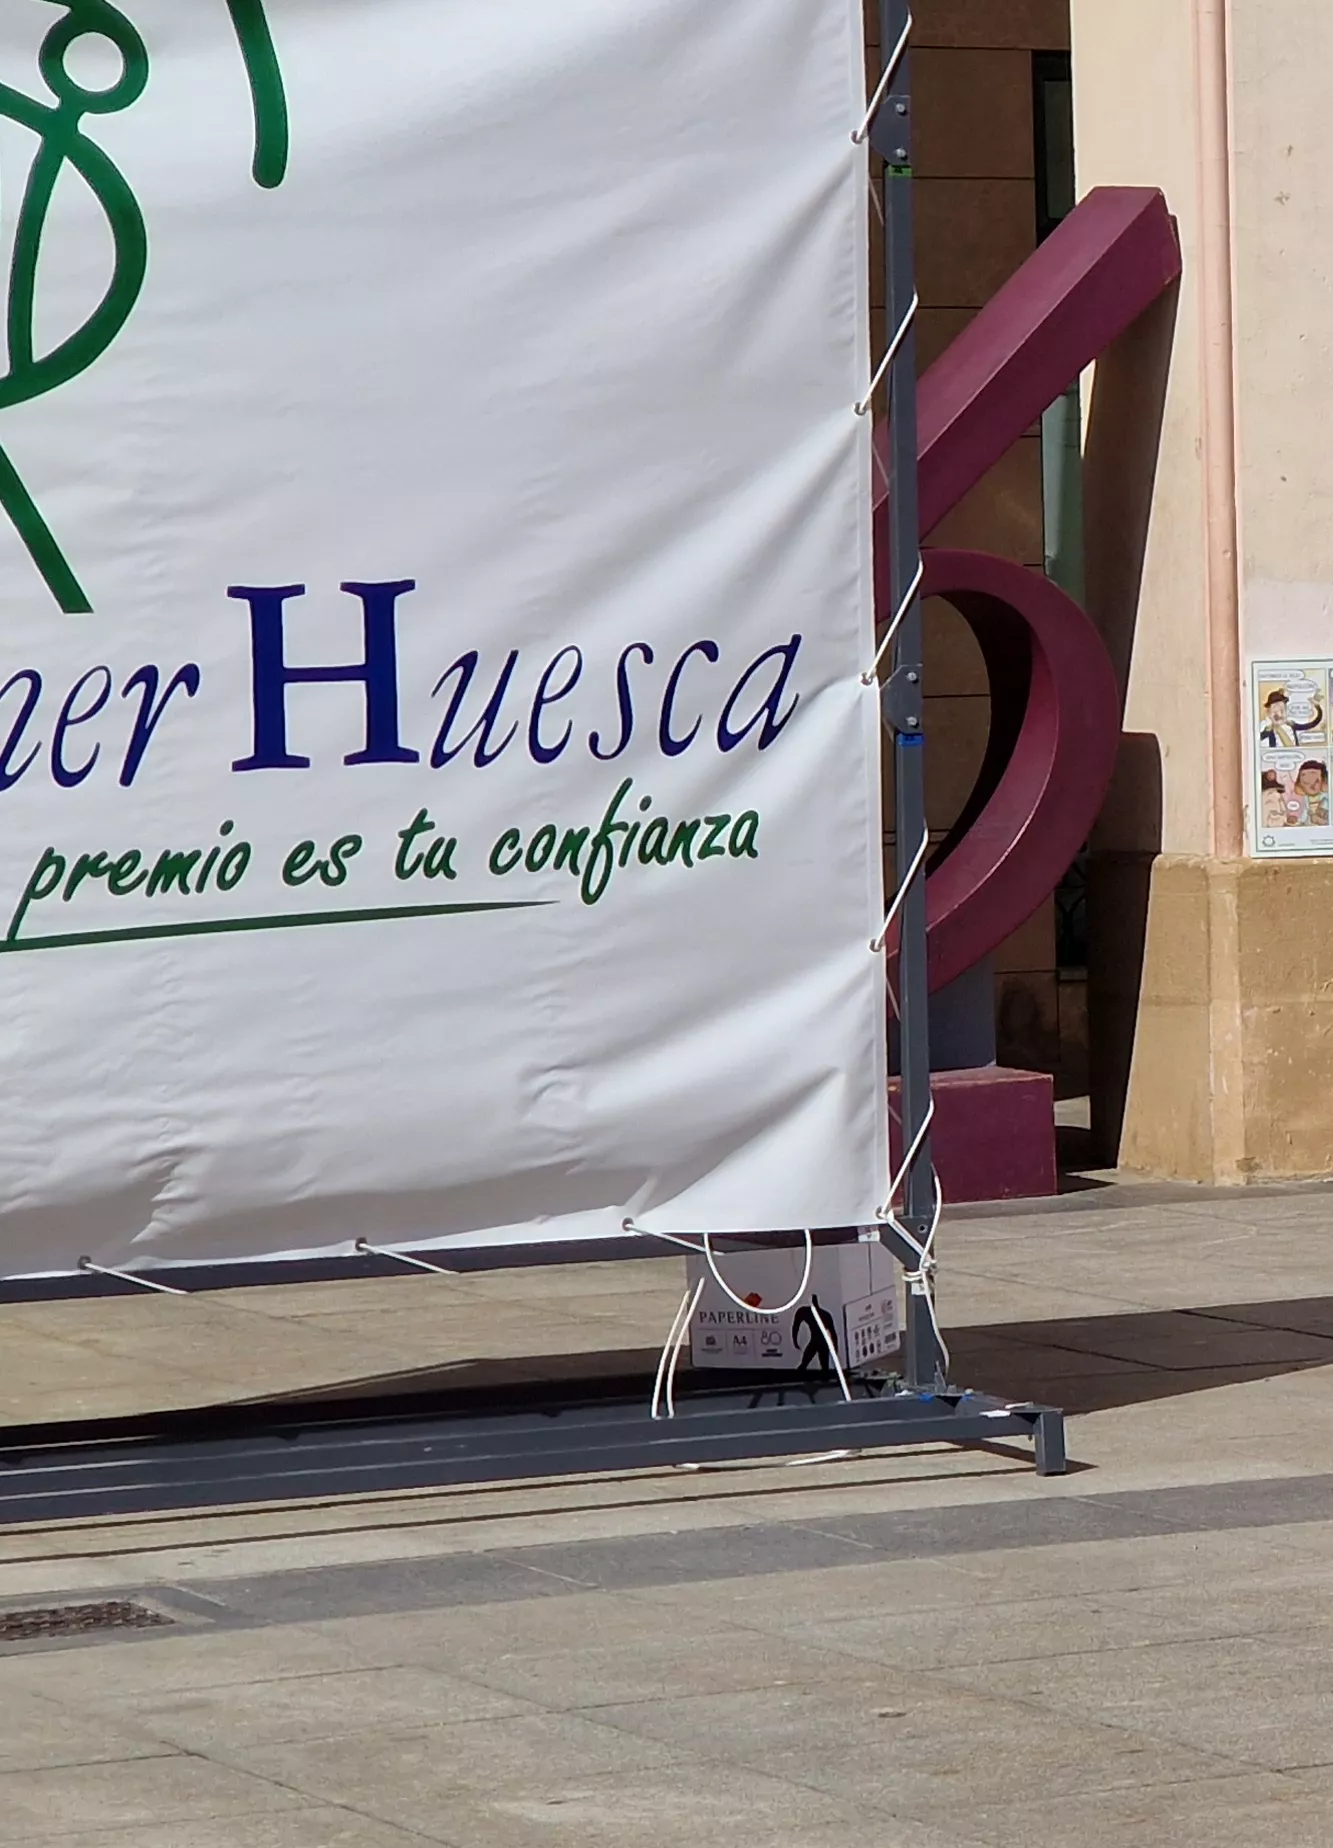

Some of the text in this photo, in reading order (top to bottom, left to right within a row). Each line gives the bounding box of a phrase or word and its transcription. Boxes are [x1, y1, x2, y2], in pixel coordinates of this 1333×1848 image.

[226, 578, 803, 772] Huesca
[7, 778, 761, 943] premio es tu confianza
[699, 1310, 780, 1325] PAPERLINE
[733, 1335, 748, 1346] A4
[760, 1330, 783, 1347] 80
